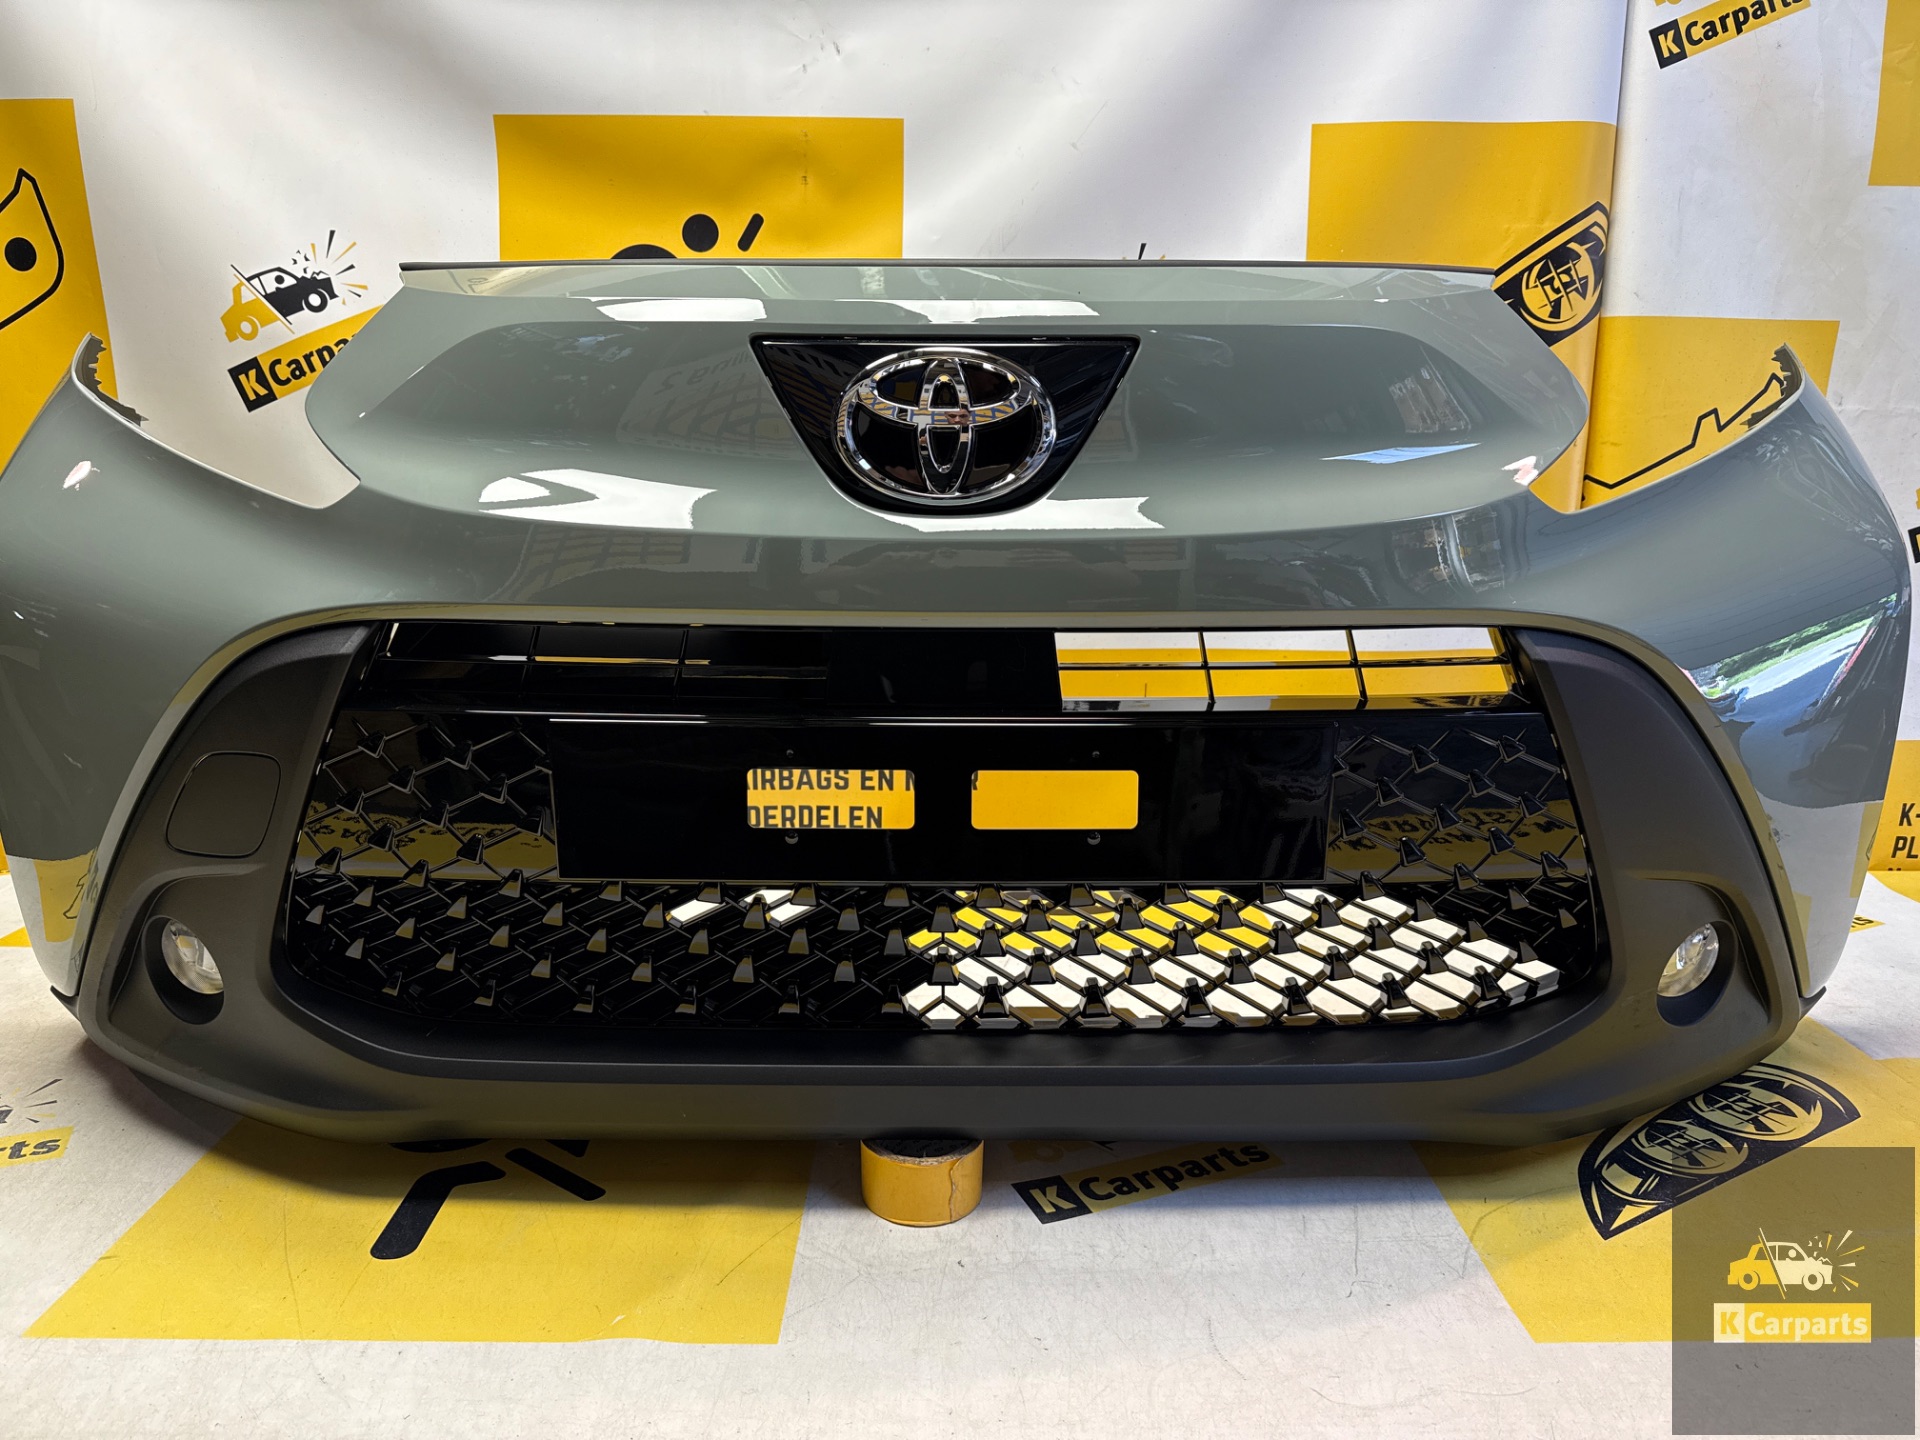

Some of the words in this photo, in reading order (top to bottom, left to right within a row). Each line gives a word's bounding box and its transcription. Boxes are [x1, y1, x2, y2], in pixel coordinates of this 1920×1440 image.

[1658, 29, 1681, 58] K
[238, 368, 269, 401] K
[747, 769, 849, 790] IRBAGS
[860, 770, 894, 791] EN
[1029, 1185, 1078, 1214] K
[1079, 1144, 1271, 1201] Carparts
